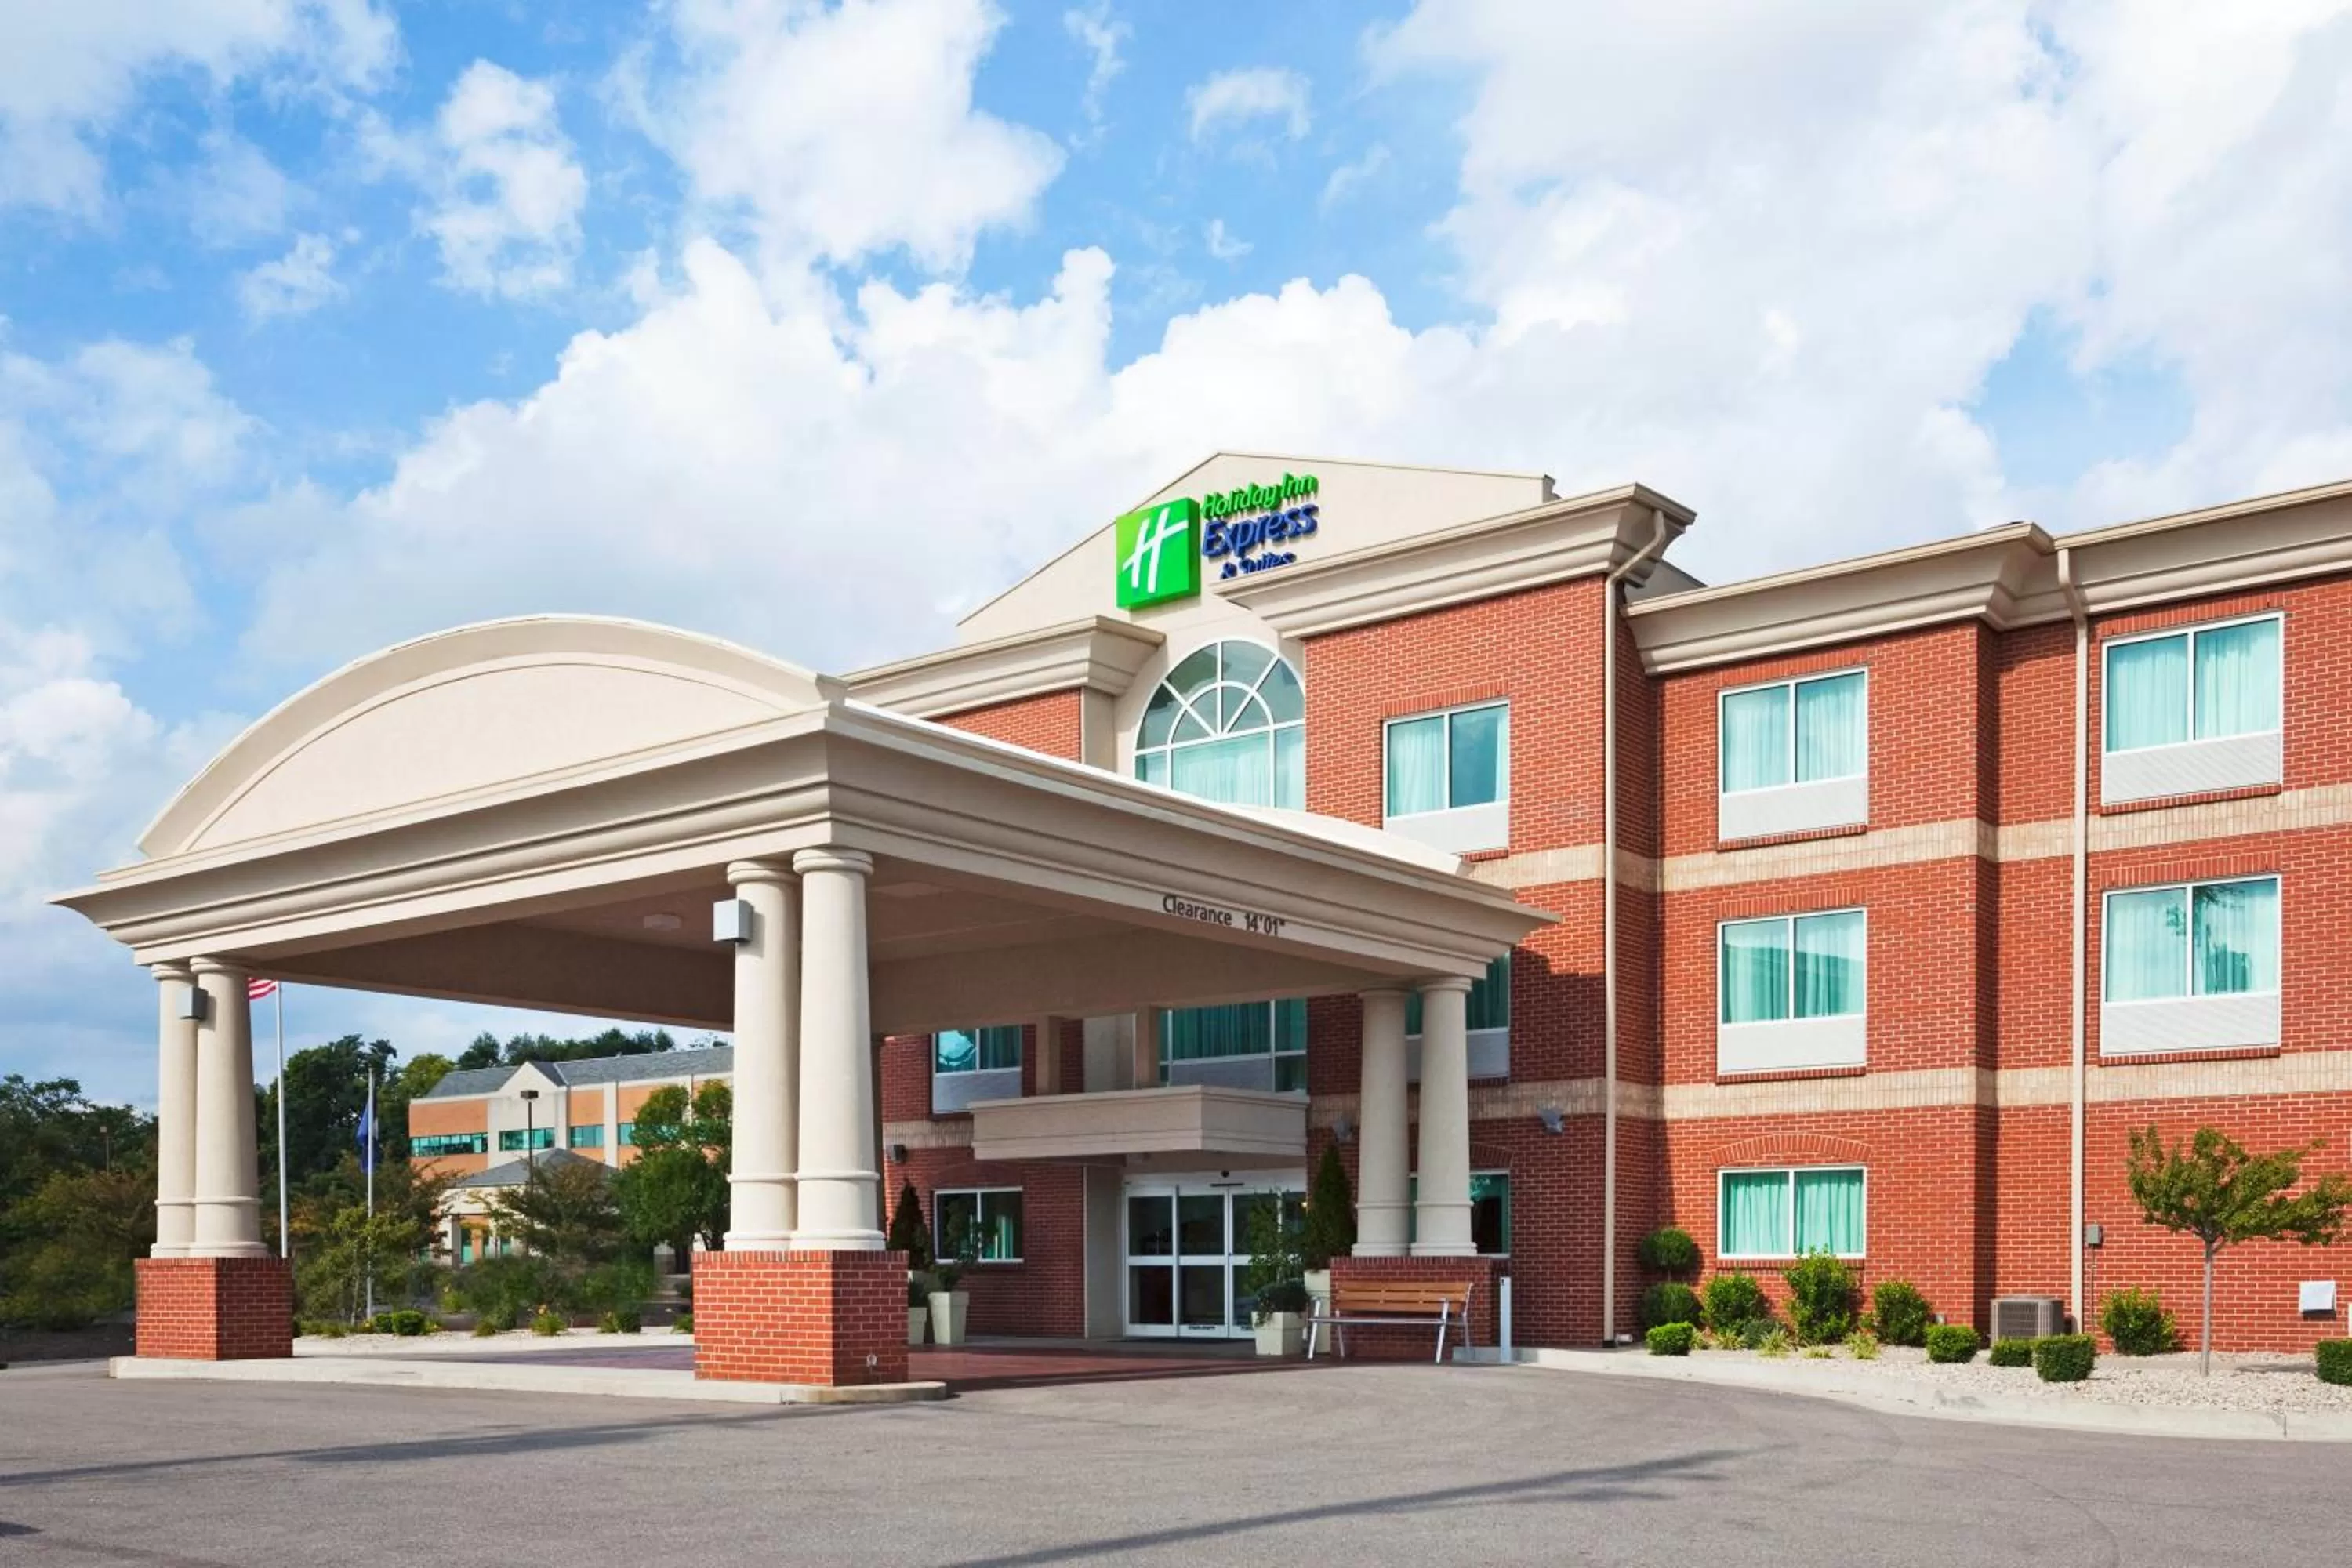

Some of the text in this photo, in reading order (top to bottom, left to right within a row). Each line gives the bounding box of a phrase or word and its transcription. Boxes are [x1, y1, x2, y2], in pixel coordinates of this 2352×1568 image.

[1201, 472, 1319, 519] Holiday Inn
[1203, 504, 1319, 557] Express
[1163, 894, 1232, 926] Clearance
